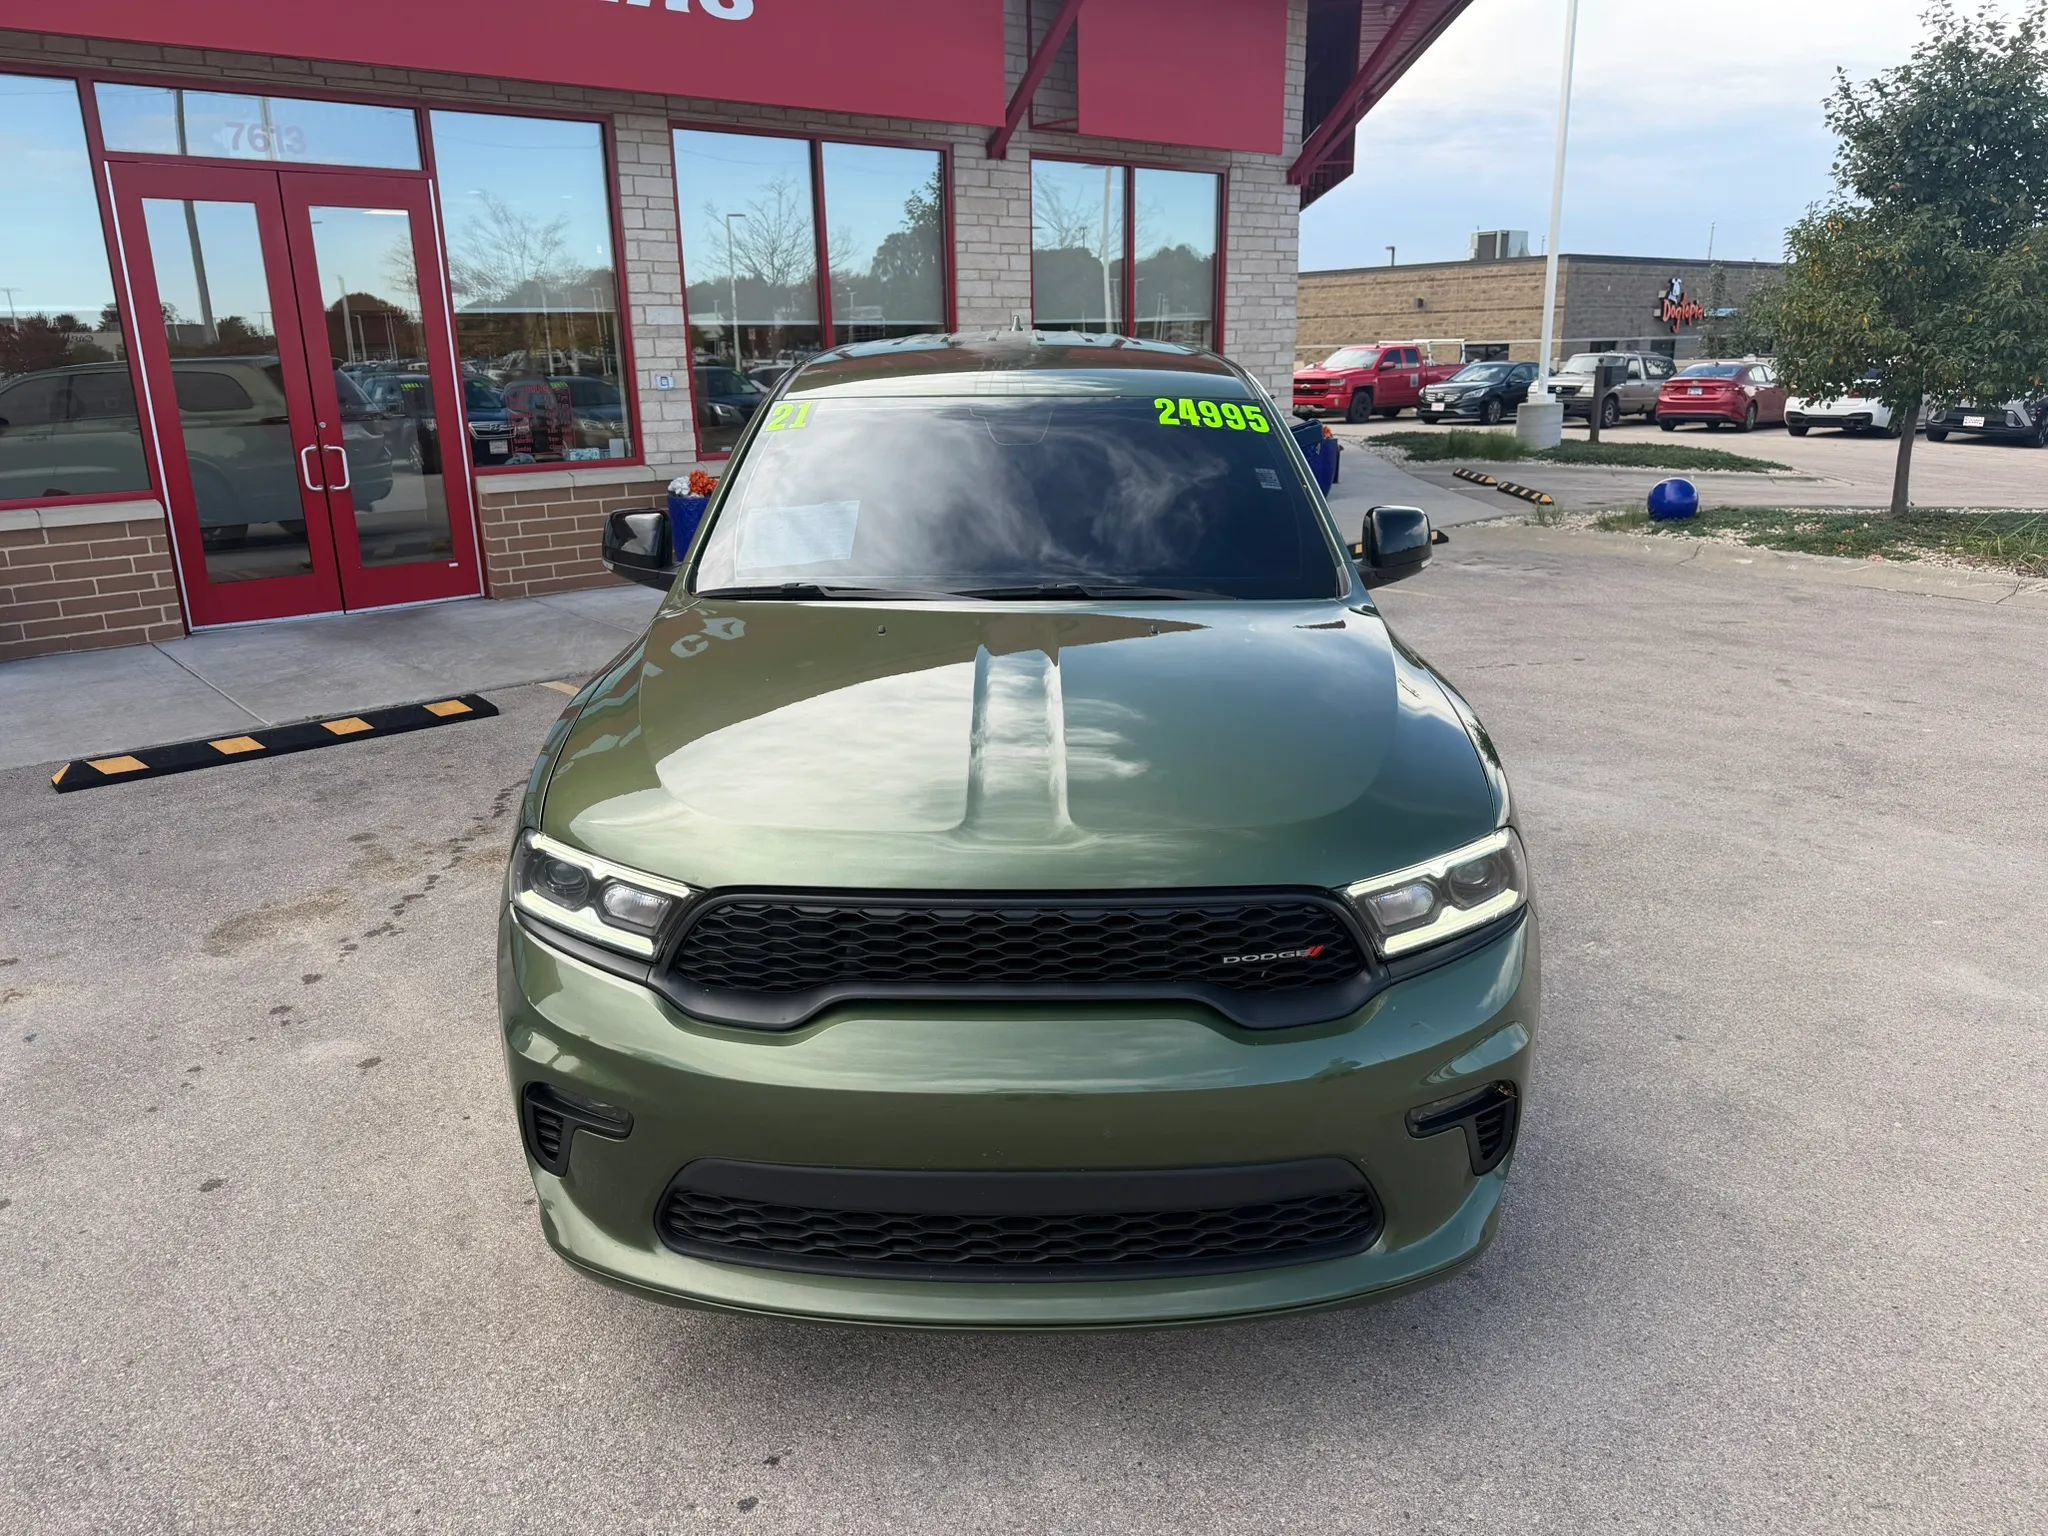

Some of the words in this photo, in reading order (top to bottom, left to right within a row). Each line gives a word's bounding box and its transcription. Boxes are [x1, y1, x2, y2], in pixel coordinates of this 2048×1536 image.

[225, 121, 306, 154] 7613
[766, 401, 811, 432] 21
[1154, 398, 1270, 433] 24995
[1223, 949, 1309, 964] DODGE
